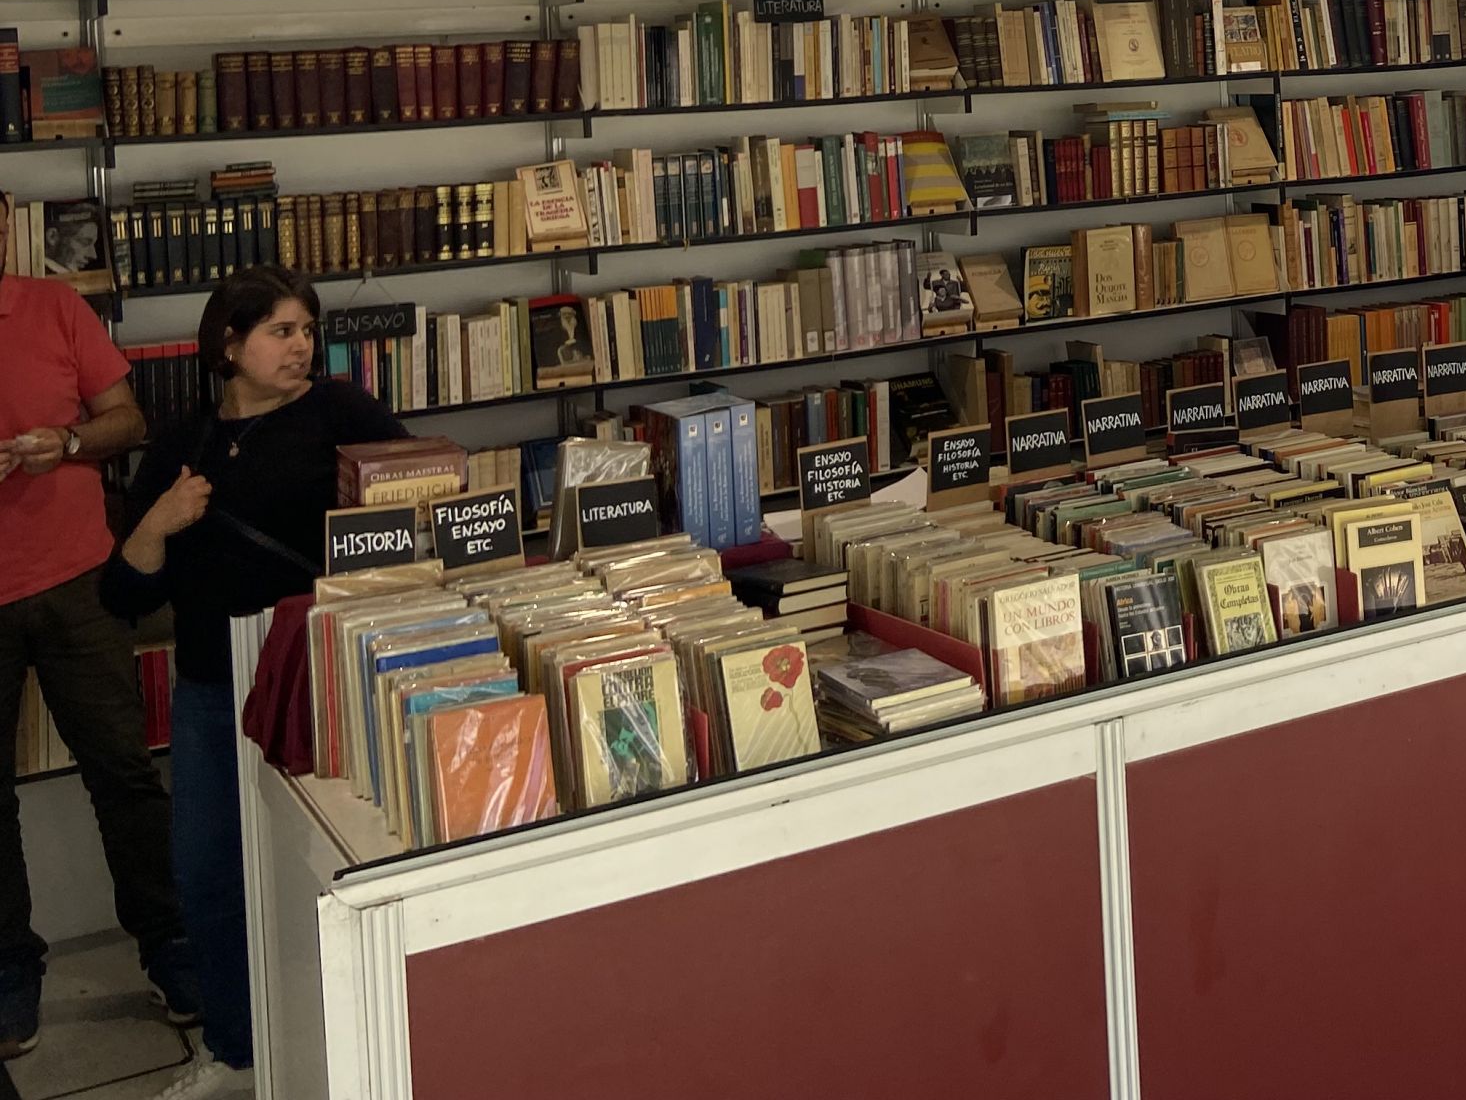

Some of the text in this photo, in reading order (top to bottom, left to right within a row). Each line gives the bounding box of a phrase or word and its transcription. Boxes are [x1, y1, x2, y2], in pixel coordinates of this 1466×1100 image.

[335, 311, 405, 335] ENSAYO
[1301, 376, 1350, 396] NARRATIVA
[1372, 366, 1418, 385] NARRATIVA
[1239, 391, 1286, 412] NARRATIVA
[1087, 412, 1141, 435] NARRATIVA
[1173, 403, 1223, 426] NARRATIVA
[944, 438, 976, 452] ENSAYO
[1012, 430, 1067, 453] NARRATIVA
[814, 450, 852, 467] ENSAYO
[937, 446, 982, 463] FILOSOFÍA
[370, 464, 455, 482] OBRAS MAESTRAS
[807, 461, 863, 482] FILOSOFÍA
[943, 459, 979, 474] HISTORIA
[373, 482, 453, 505] FRIEDRICH
[814, 478, 862, 494] HISTORIA
[435, 494, 515, 526] FILOSOFÍA
[582, 499, 653, 523] LITERATURA
[452, 518, 506, 540] ENSAYO
[1367, 524, 1403, 536] Albert Cohen
[333, 528, 413, 559] HISTORIA
[1037, 581, 1075, 598] SALVADOR
[1223, 583, 1250, 596] Obras
[1003, 598, 1076, 624] UN MUNDO
[1220, 596, 1260, 610] Completas
[1004, 611, 1076, 636] CON LIBROS
